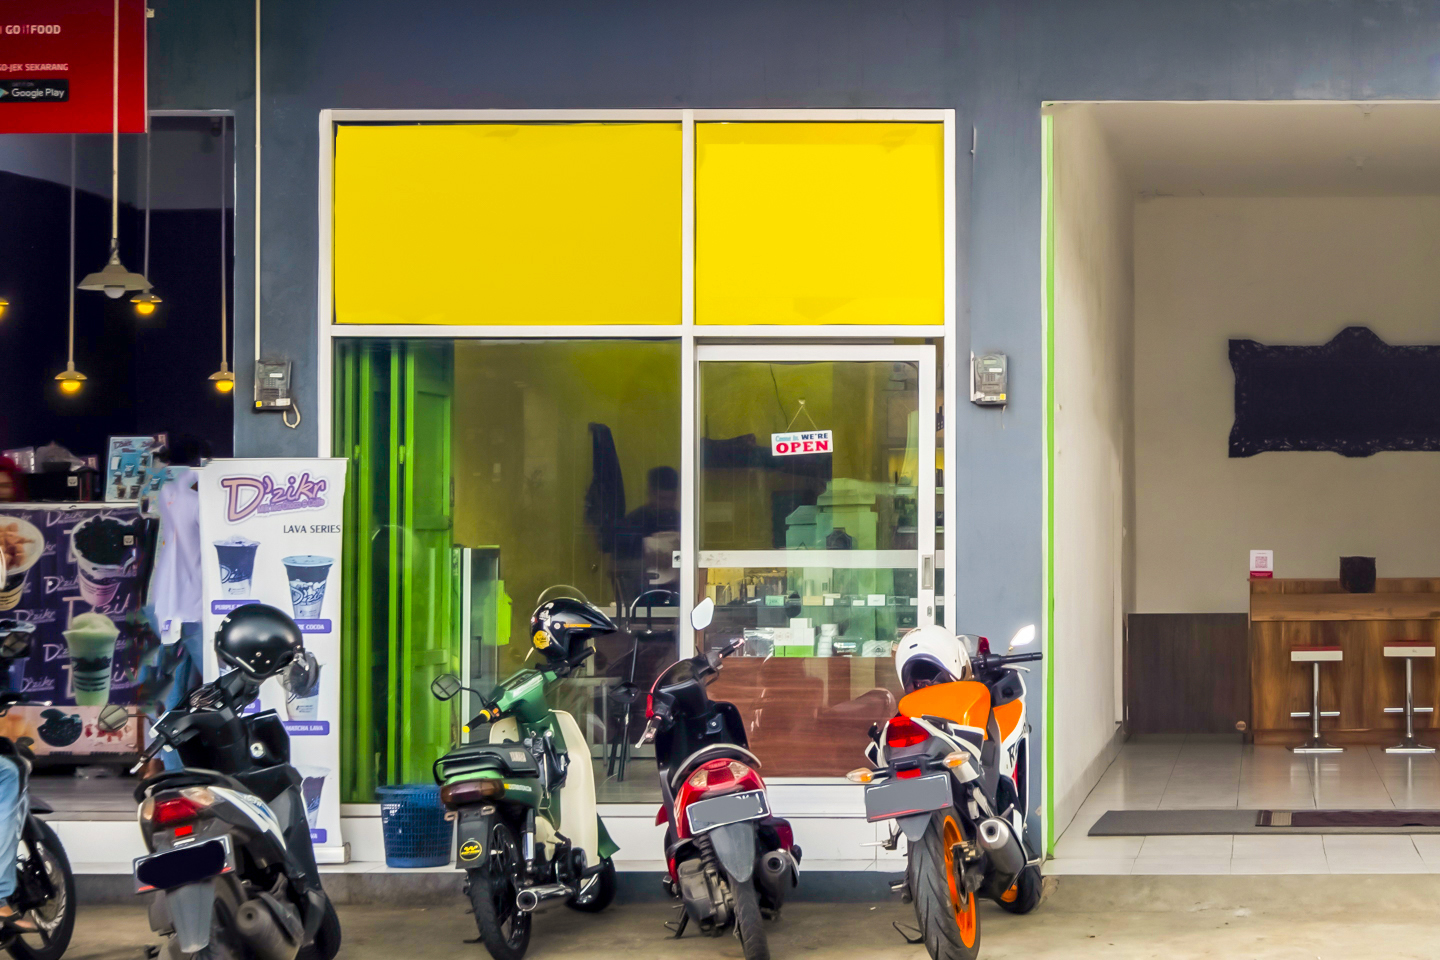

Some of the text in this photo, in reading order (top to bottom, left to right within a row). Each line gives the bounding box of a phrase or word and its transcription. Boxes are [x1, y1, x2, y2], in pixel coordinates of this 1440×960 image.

[24, 63, 69, 72] SEKARANG
[11, 88, 65, 99] Google Play
[776, 440, 829, 454] OPEN
[221, 472, 326, 522] D'zikr
[283, 525, 341, 534] LAVA SERIES
